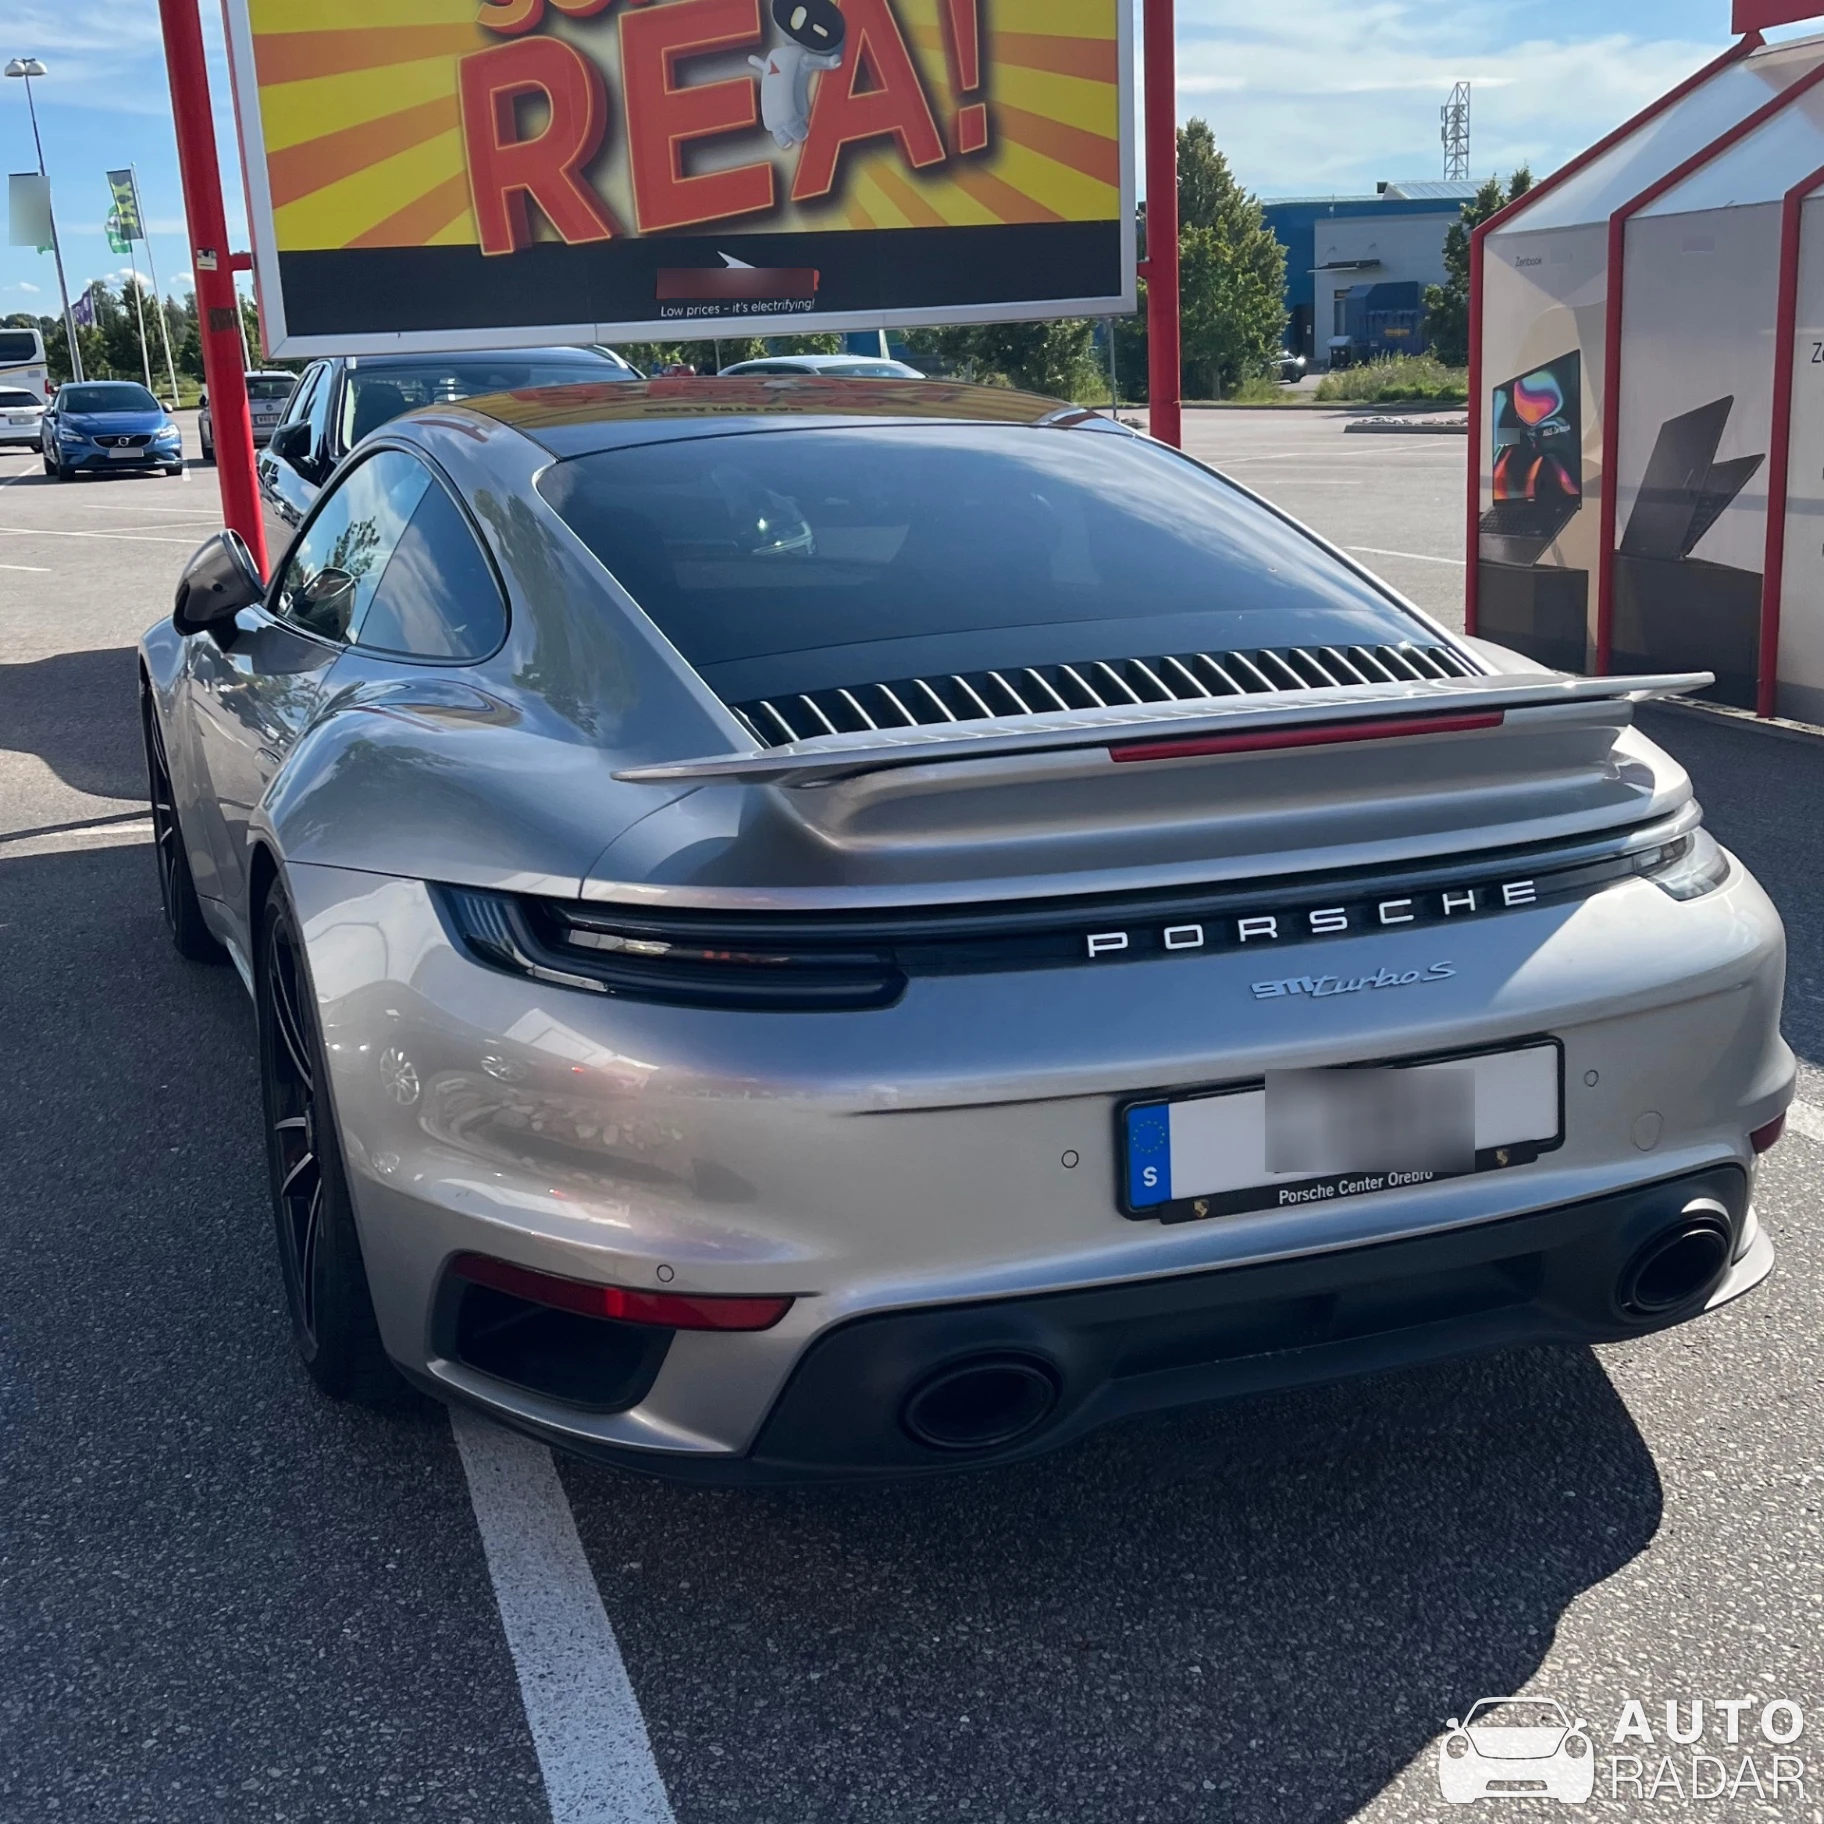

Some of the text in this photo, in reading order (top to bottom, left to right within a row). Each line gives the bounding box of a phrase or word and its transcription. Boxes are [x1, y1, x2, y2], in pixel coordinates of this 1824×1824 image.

[459, 0, 988, 257] REA!
[660, 306, 683, 317] Low
[686, 304, 720, 317] prices
[750, 298, 815, 313] electrifying!
[1087, 880, 1537, 958] PORSCHE
[1251, 975, 1315, 999] 911
[1422, 961, 1457, 981] S
[1142, 1166, 1158, 1188] S
[1279, 1184, 1335, 1205] Porsche
[1338, 1176, 1384, 1195] Center
